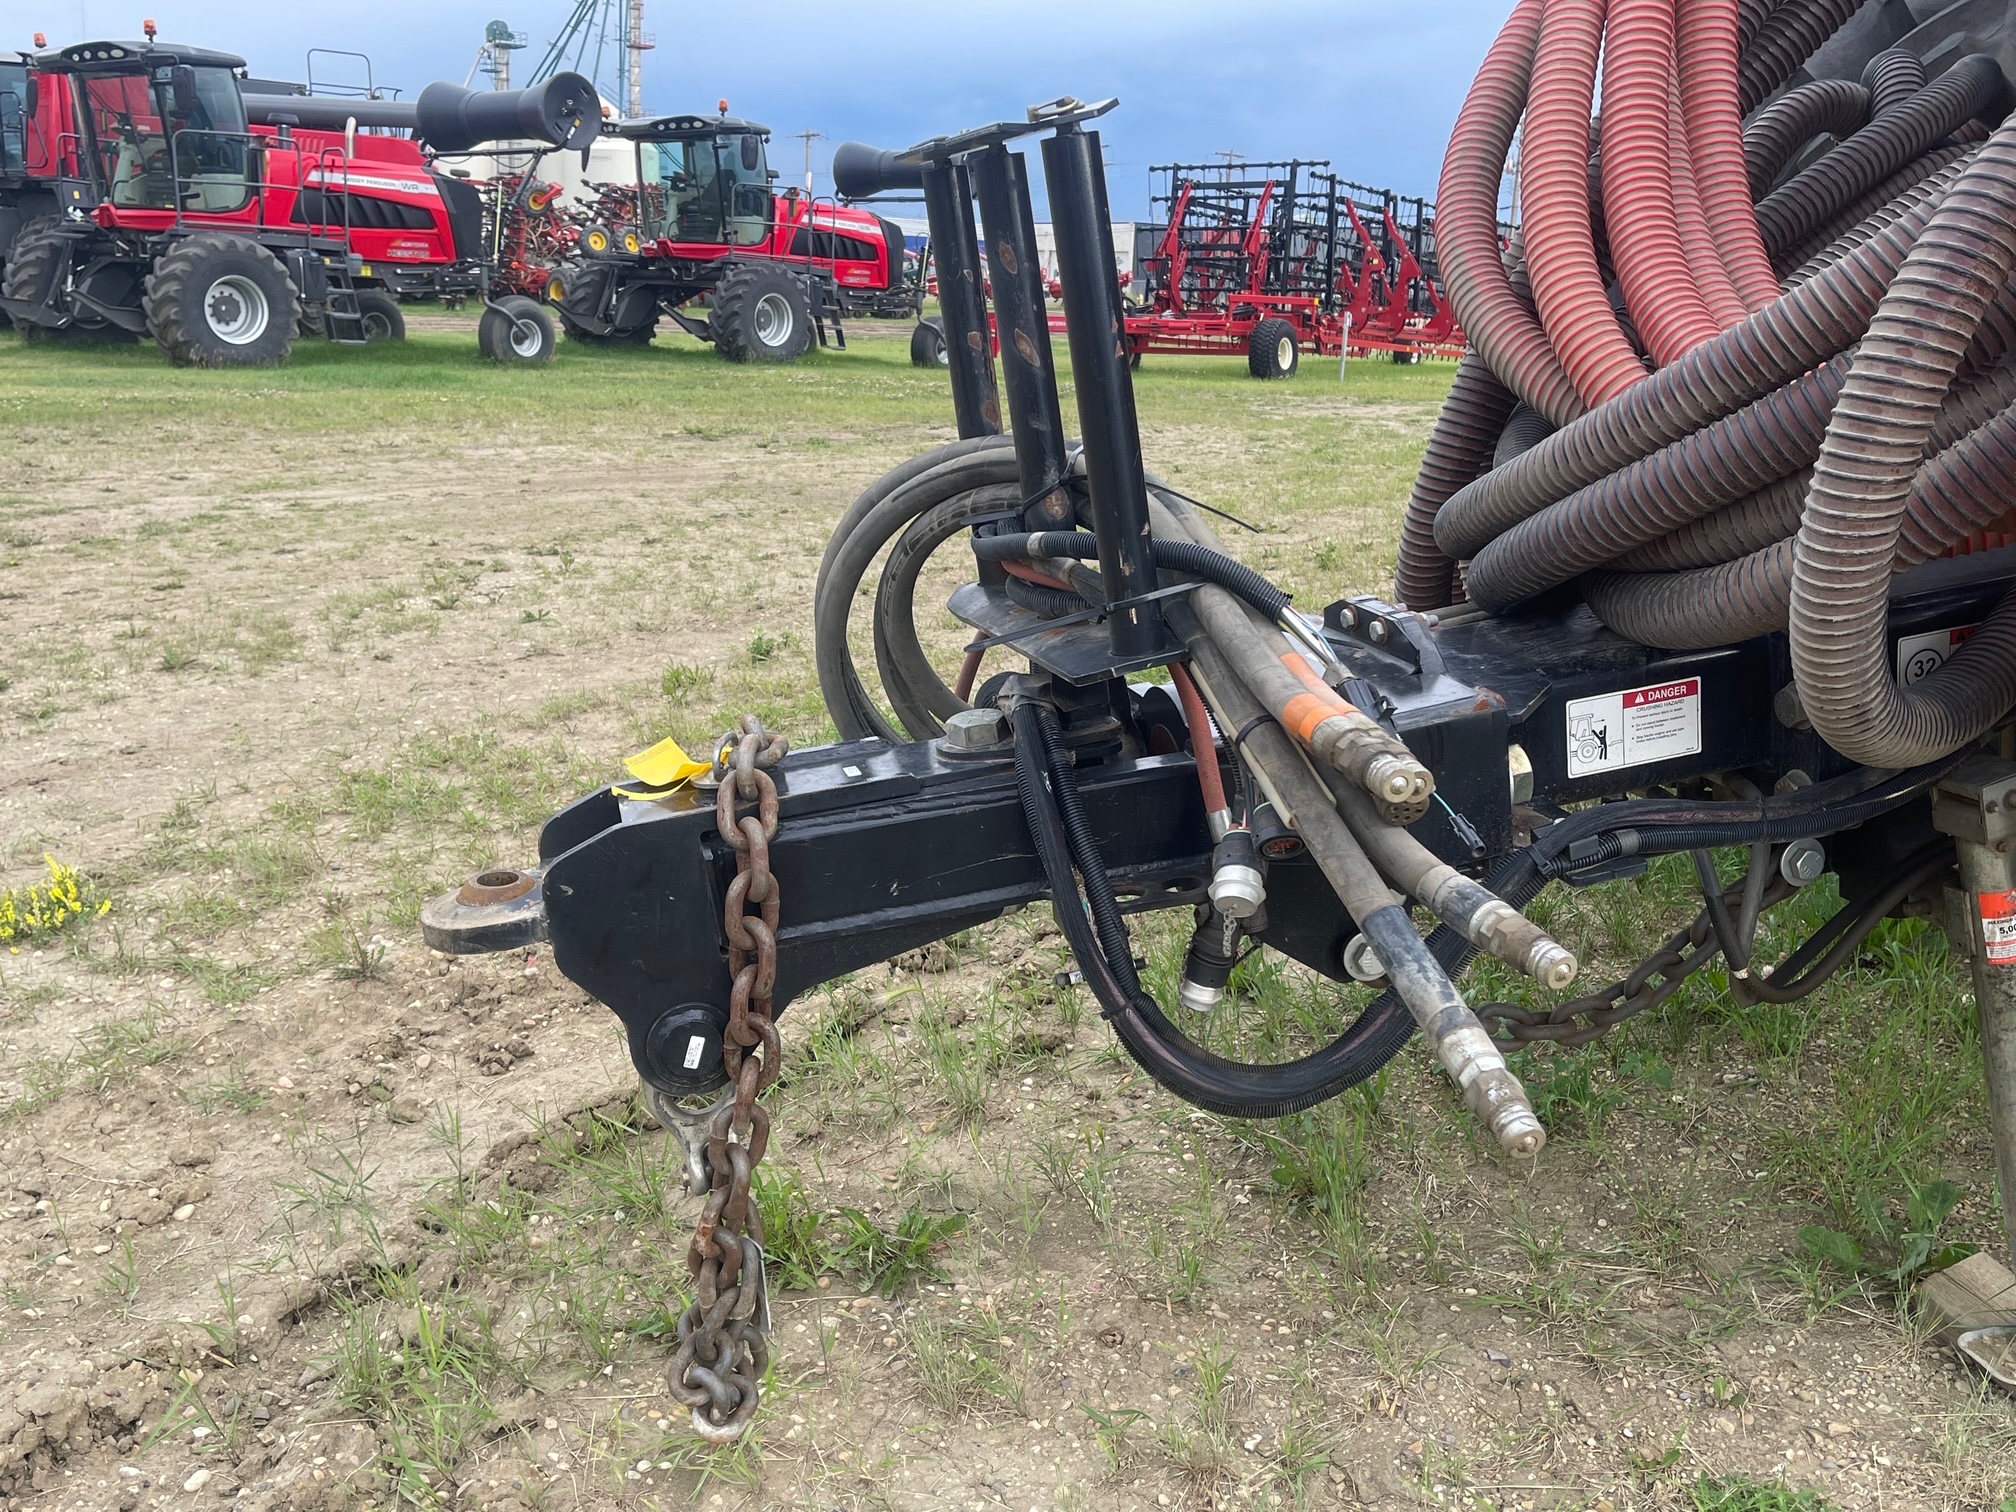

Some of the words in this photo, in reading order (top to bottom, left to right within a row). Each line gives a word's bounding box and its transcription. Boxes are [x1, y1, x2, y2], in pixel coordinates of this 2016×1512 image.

[401, 182, 419, 191] WR
[1914, 657, 1936, 678] 32
[1648, 685, 1687, 701] DANGER
[1636, 702, 1663, 713] CRUSHING
[1664, 699, 1685, 708] HAZARD
